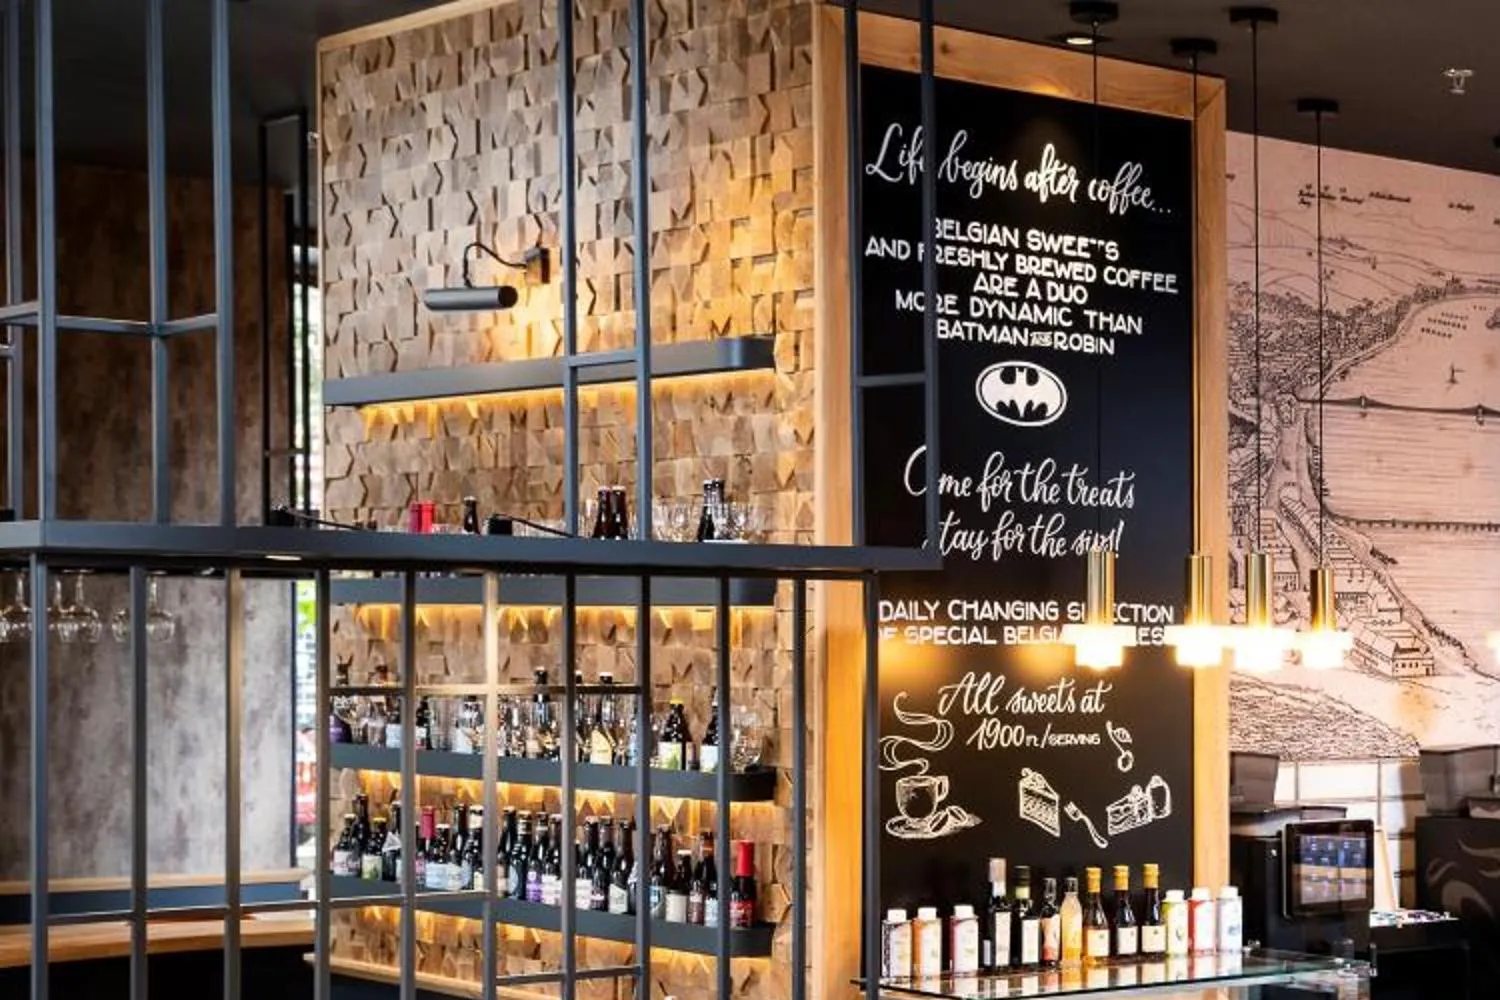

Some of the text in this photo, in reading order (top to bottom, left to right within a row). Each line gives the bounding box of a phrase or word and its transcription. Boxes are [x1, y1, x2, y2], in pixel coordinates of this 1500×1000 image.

[938, 129, 1018, 199] begins
[1024, 143, 1080, 203] after
[865, 236, 911, 260] AND
[1015, 254, 1096, 283] BREWED
[1103, 266, 1178, 294] COFFEE
[973, 272, 1088, 305] ARE A DUO
[969, 296, 1073, 327] DYNAMIC
[1084, 309, 1143, 335] THAN
[937, 319, 1029, 347] BATMAN
[1054, 331, 1115, 355] ROBIN
[904, 445, 1136, 512] Cme for the treats
[921, 511, 989, 561] tay
[991, 510, 1025, 561] for
[1028, 513, 1068, 558] the
[878, 600, 940, 621] DAILY
[947, 599, 1059, 622] CHANGING
[904, 625, 997, 645] SPECIAL
[938, 671, 1112, 715] All sweets at
